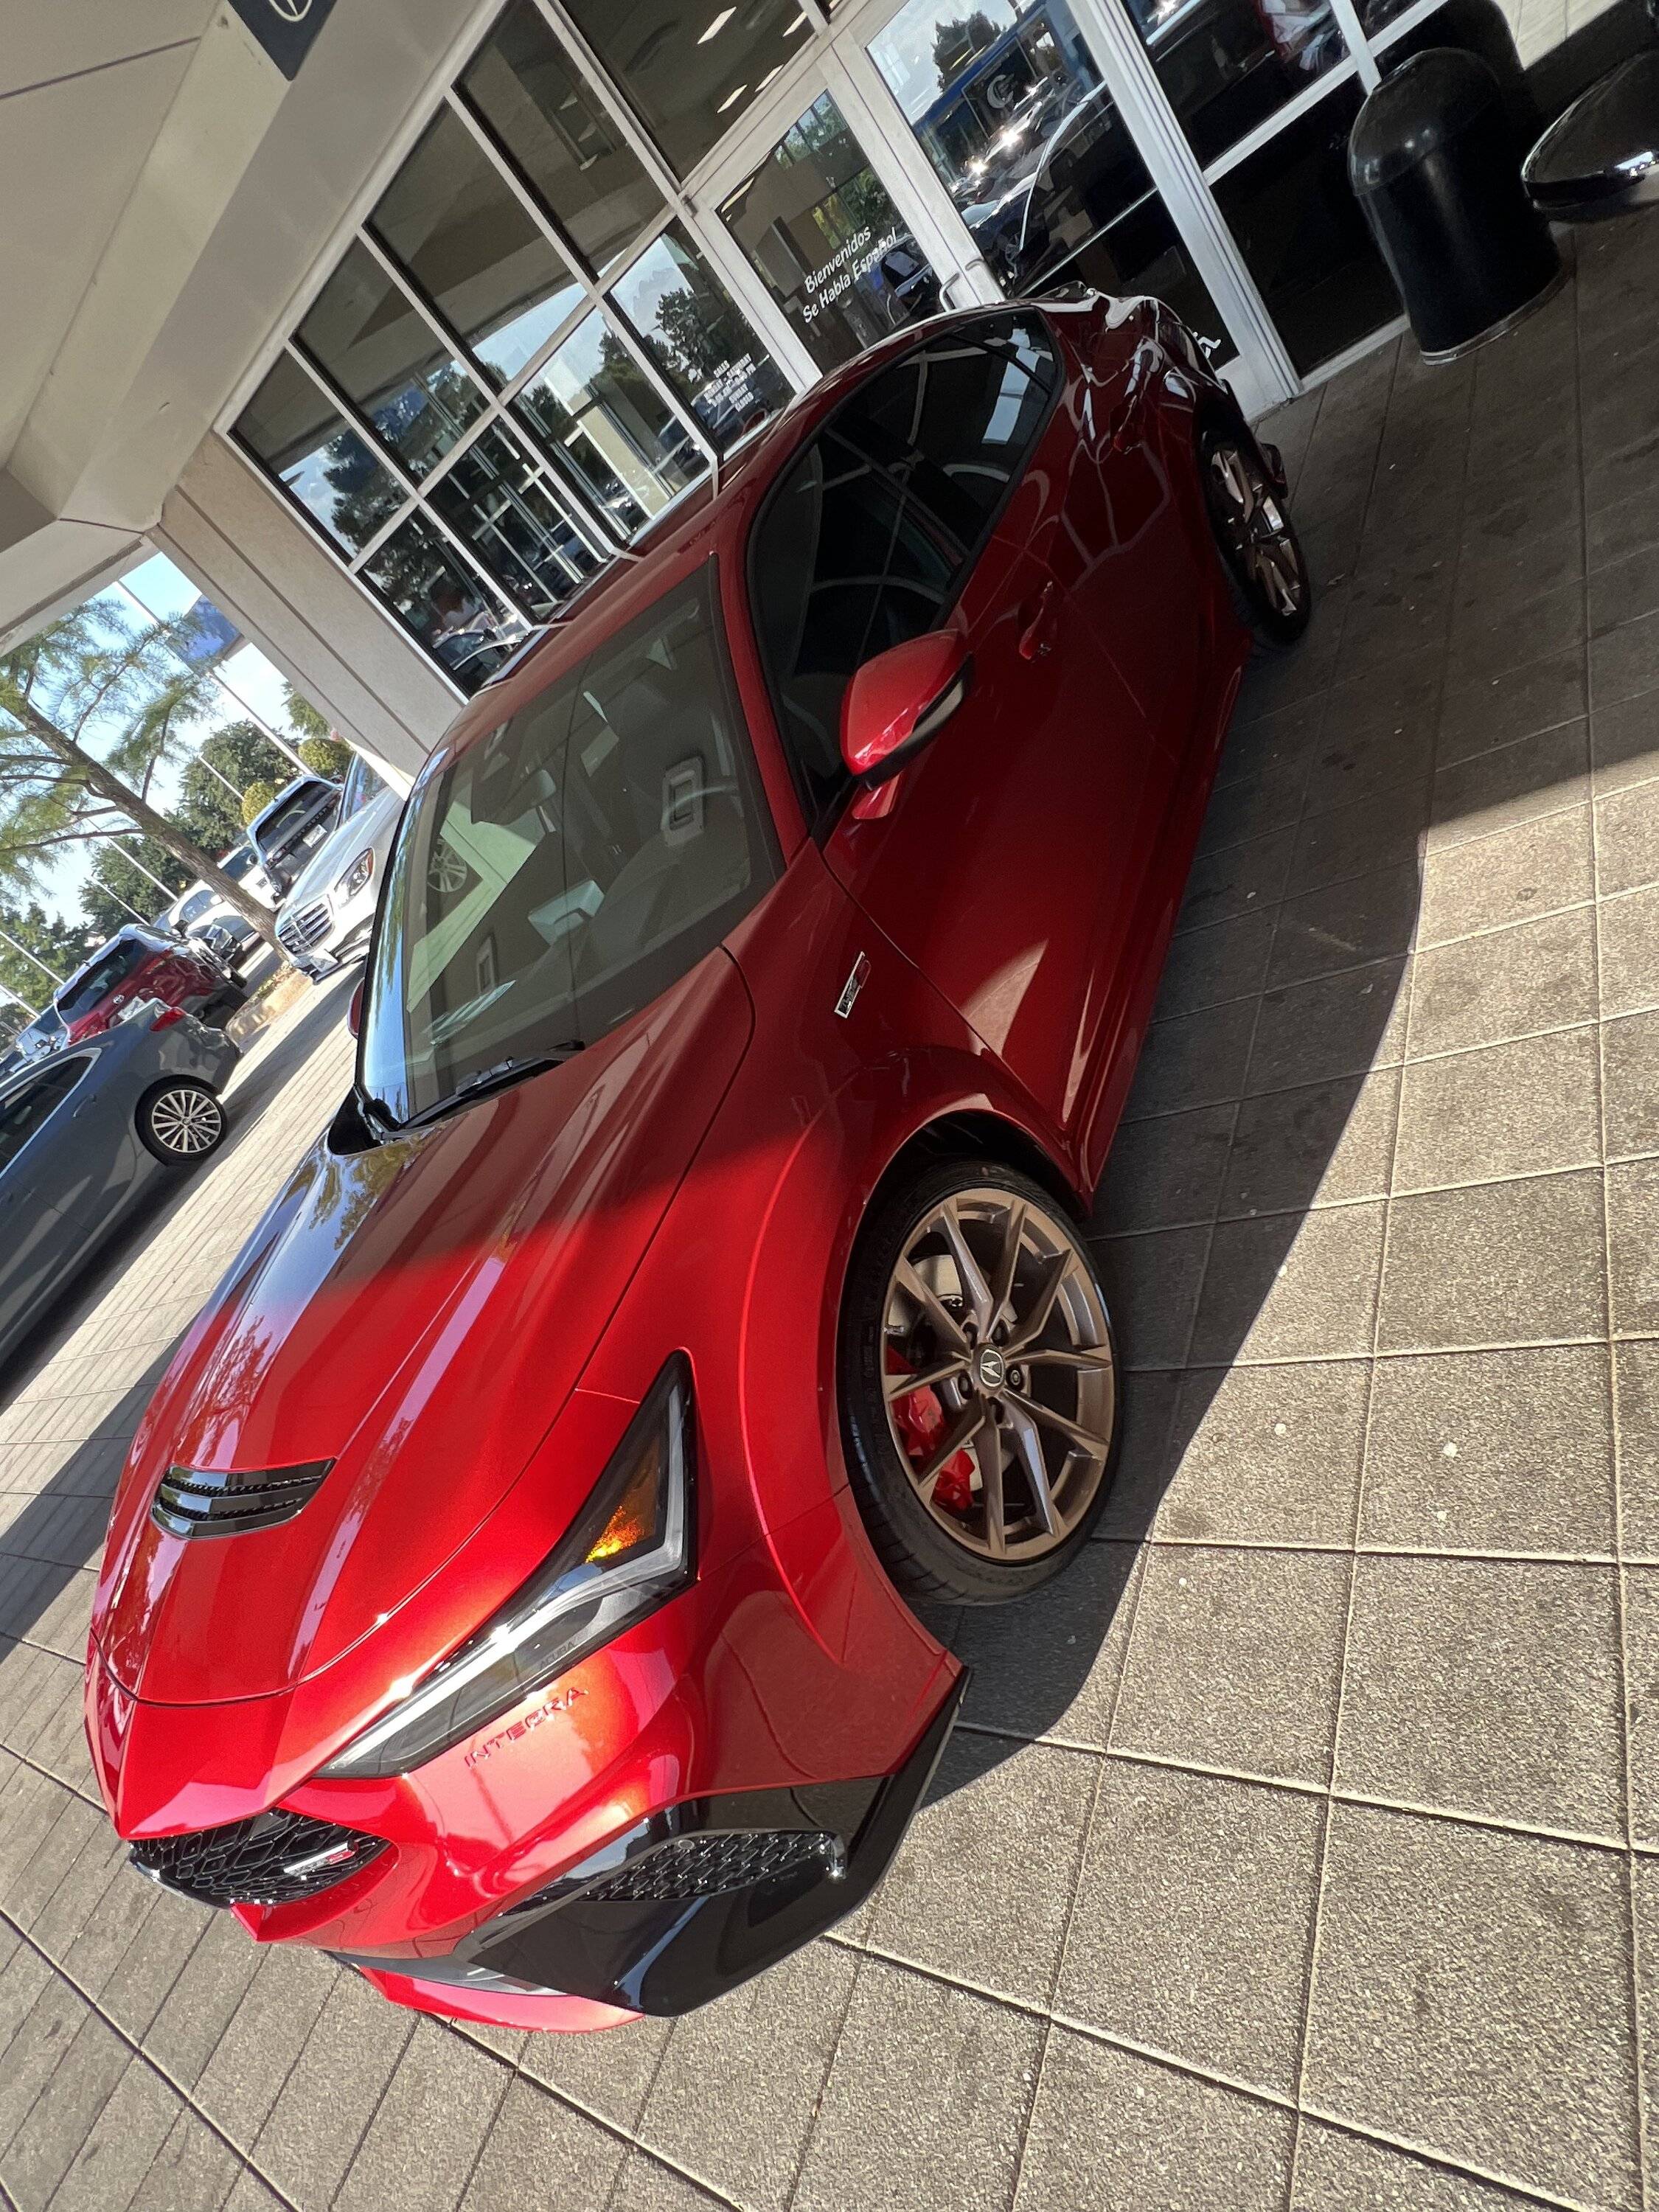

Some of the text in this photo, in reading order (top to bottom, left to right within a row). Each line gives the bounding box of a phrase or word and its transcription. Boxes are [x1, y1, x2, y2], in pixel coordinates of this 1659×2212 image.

[803, 226, 897, 323] Se Habla Español
[804, 226, 871, 293] Bienvenidos
[713, 360, 730, 378] SALES
[464, 1686, 589, 1768] INTEGRA
